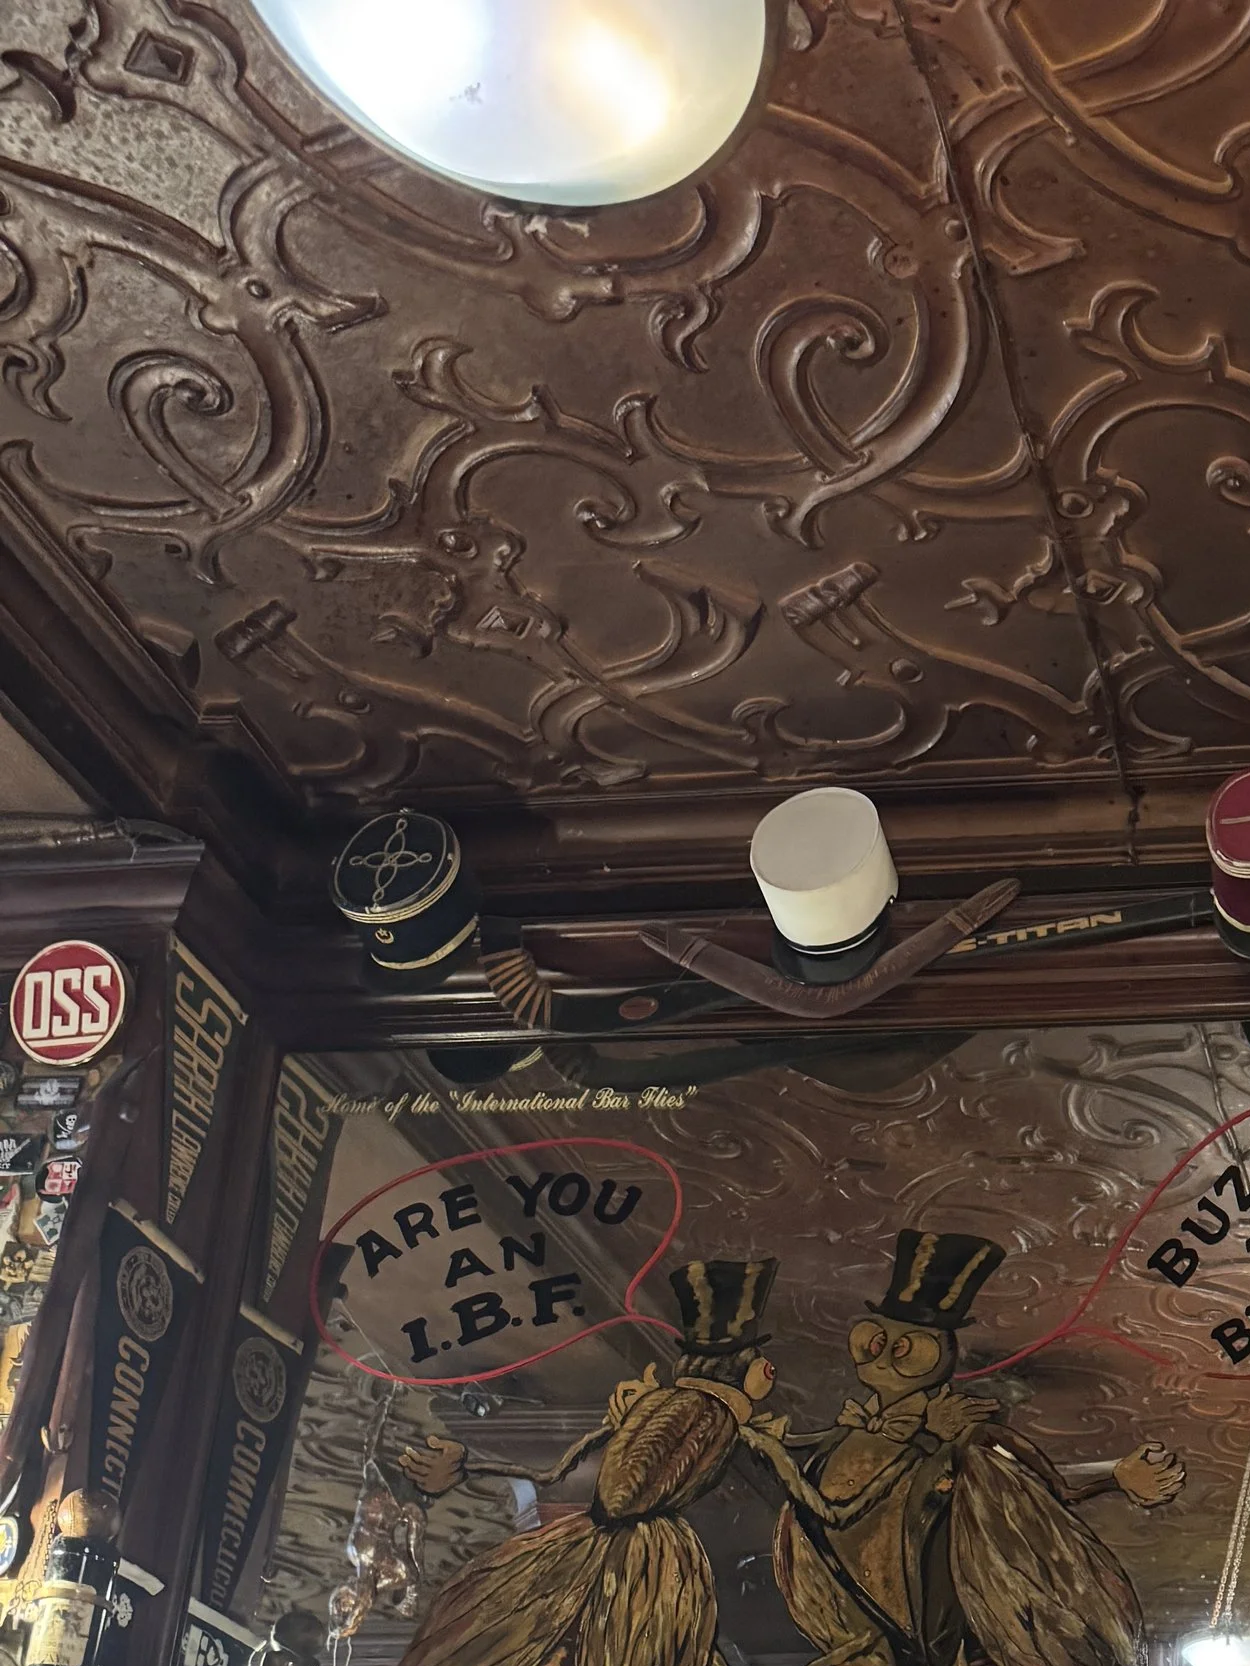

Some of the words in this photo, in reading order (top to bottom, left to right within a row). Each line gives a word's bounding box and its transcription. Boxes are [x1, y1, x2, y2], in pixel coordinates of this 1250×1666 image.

[22, 965, 112, 1039] OSS
[320, 1090, 377, 1116] Home
[384, 1091, 407, 1122] of
[410, 1092, 441, 1113] the
[592, 1086, 630, 1110] Bar
[355, 1184, 483, 1279] ARE
[506, 1172, 643, 1225] YOU
[444, 1232, 546, 1288] AN
[401, 1272, 586, 1363] I.B.F.
